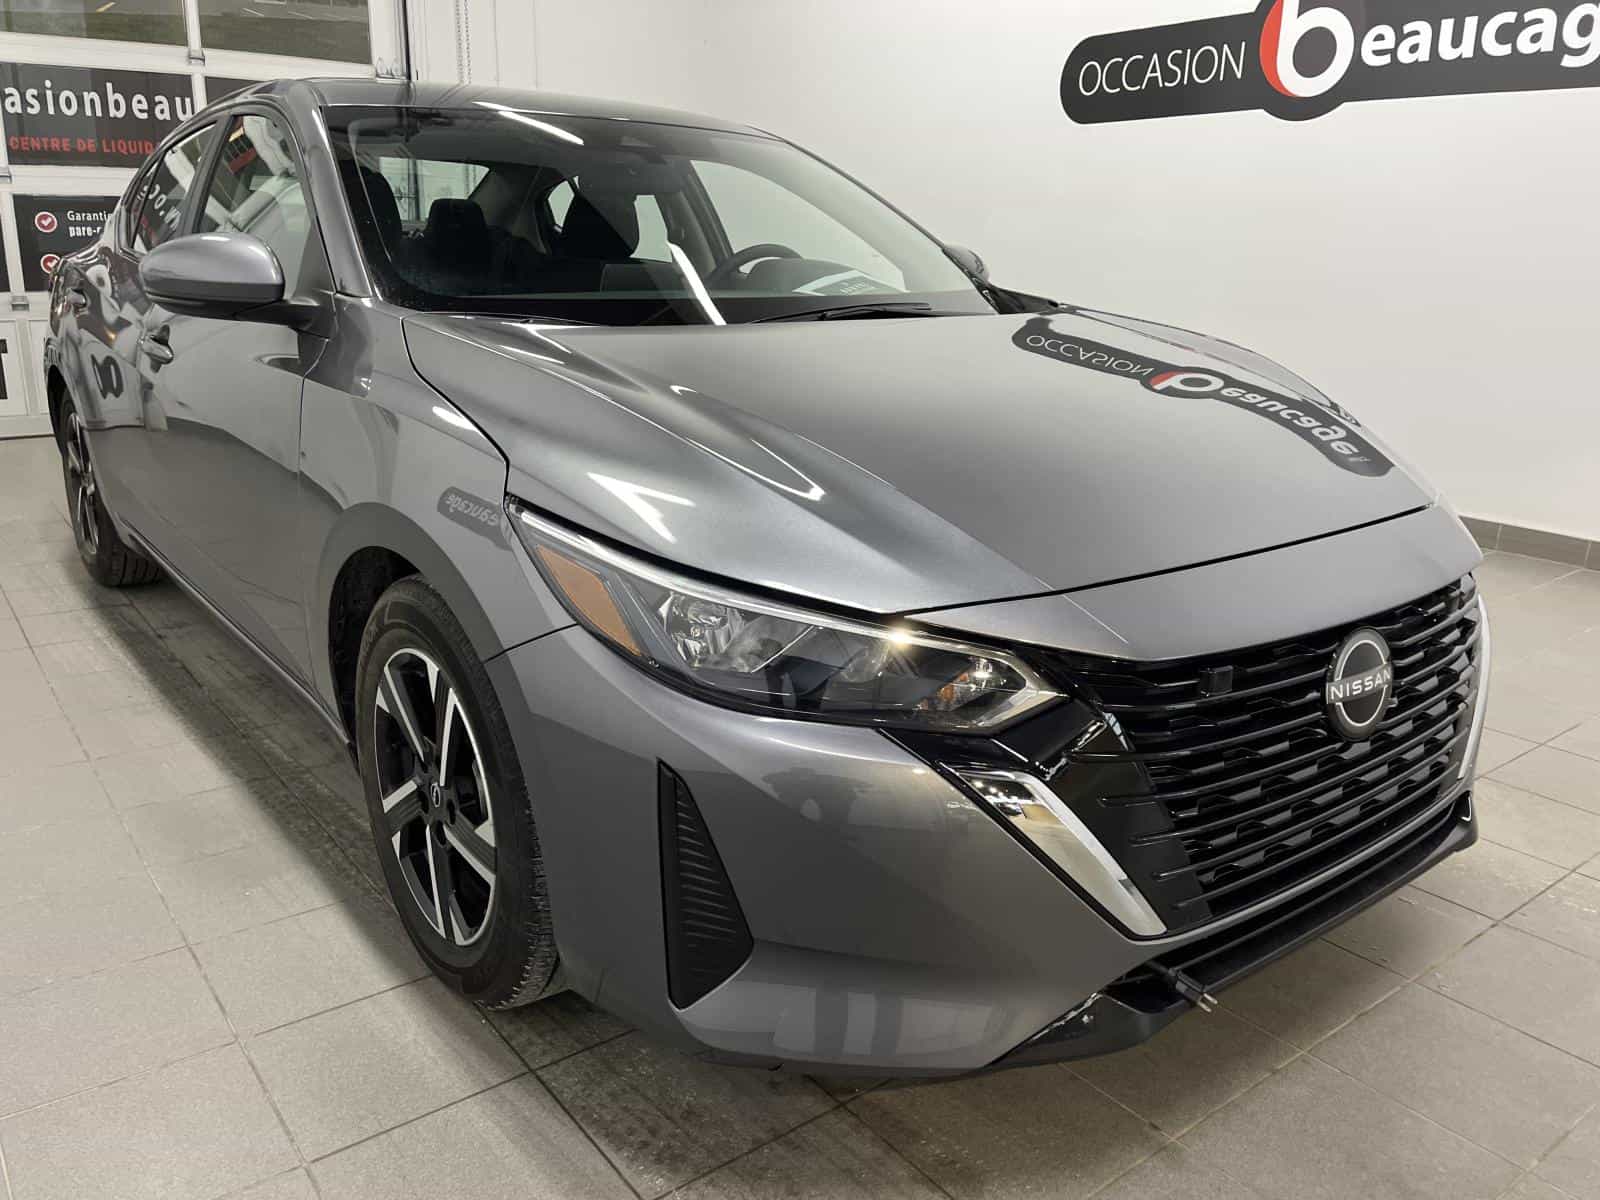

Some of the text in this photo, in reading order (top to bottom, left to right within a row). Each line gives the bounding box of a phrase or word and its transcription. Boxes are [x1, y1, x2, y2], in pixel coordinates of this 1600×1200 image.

[1078, 41, 1246, 96] OCCASION
[4, 80, 193, 121] asionbeau
[9, 135, 158, 156] CENTRE DE LIQUID
[1330, 669, 1391, 700] NISSAN
